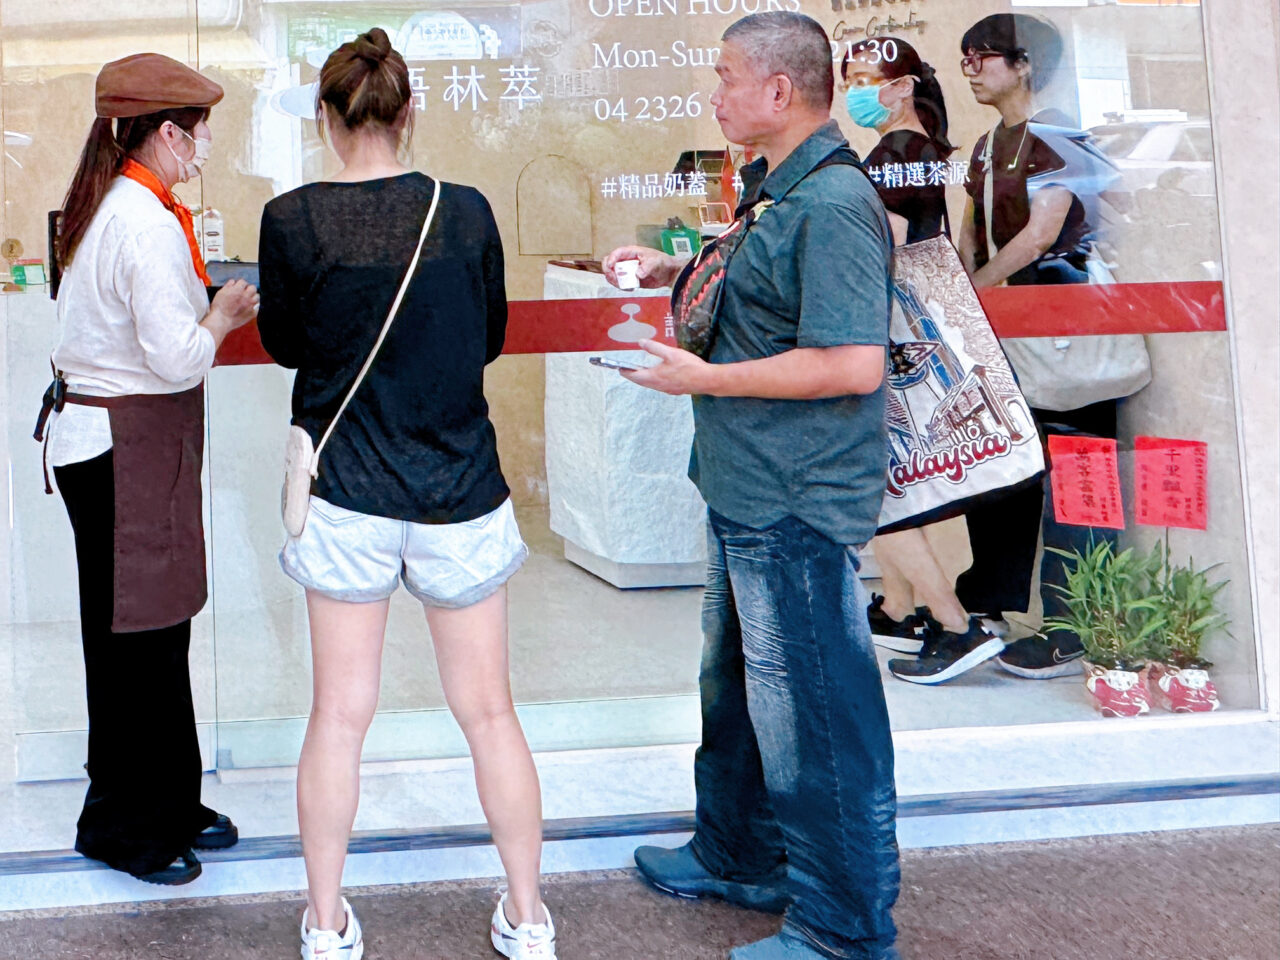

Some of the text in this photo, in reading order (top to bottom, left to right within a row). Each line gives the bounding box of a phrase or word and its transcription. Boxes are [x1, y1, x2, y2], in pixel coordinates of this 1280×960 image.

[592, 40, 720, 69] Mon-Sun
[594, 98, 629, 122] 04
[634, 92, 702, 120] 2326
[601, 171, 708, 200] #精品奶蓋
[869, 158, 971, 188] #精選茶源
[887, 434, 1008, 497] alaysia
